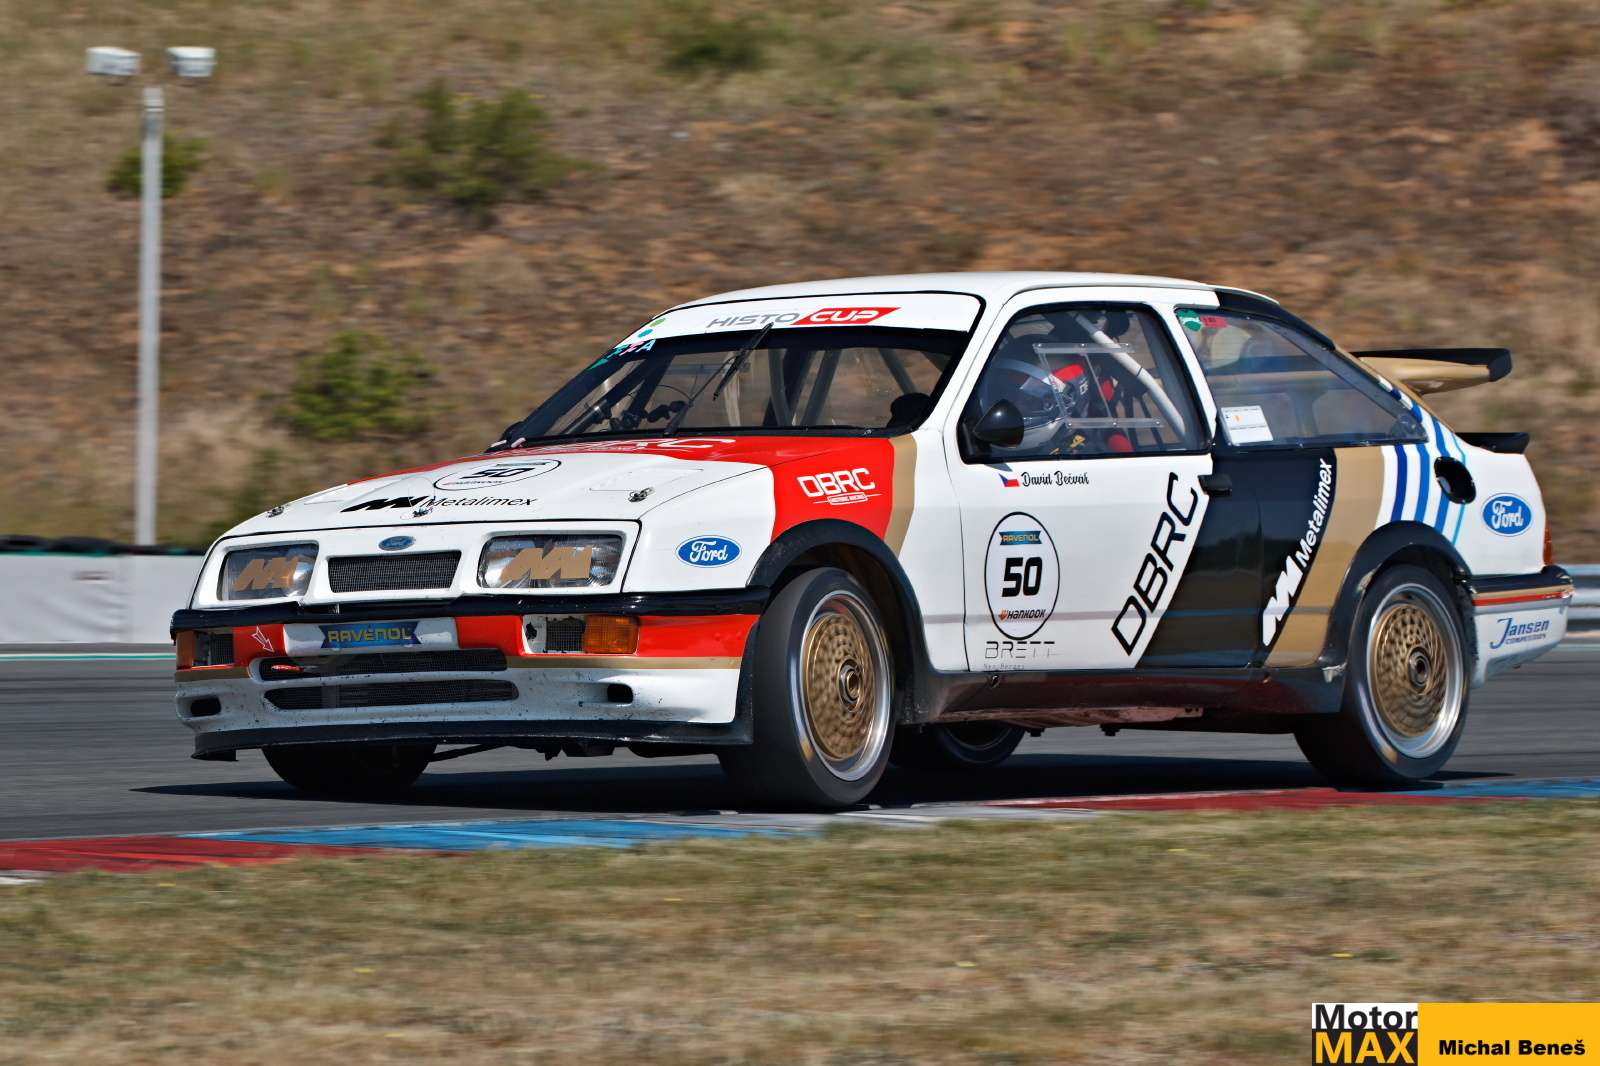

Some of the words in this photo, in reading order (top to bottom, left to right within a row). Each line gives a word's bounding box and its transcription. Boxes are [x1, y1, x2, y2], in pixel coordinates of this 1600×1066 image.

[706, 313, 800, 328] HISTO
[809, 310, 880, 322] CUP
[459, 467, 536, 480] 50
[797, 467, 876, 498] DBRC
[1020, 471, 1052, 487] David
[420, 496, 537, 508] Metalimex
[1295, 458, 1333, 568] Metalimex
[1491, 500, 1525, 530] Ford
[1002, 534, 1039, 543] RAVENOL
[689, 540, 729, 563] Ford
[1111, 471, 1198, 657] DBRC
[1001, 557, 1043, 598] 50
[327, 627, 412, 643] RAVENOL
[1490, 617, 1550, 649] Jansen
